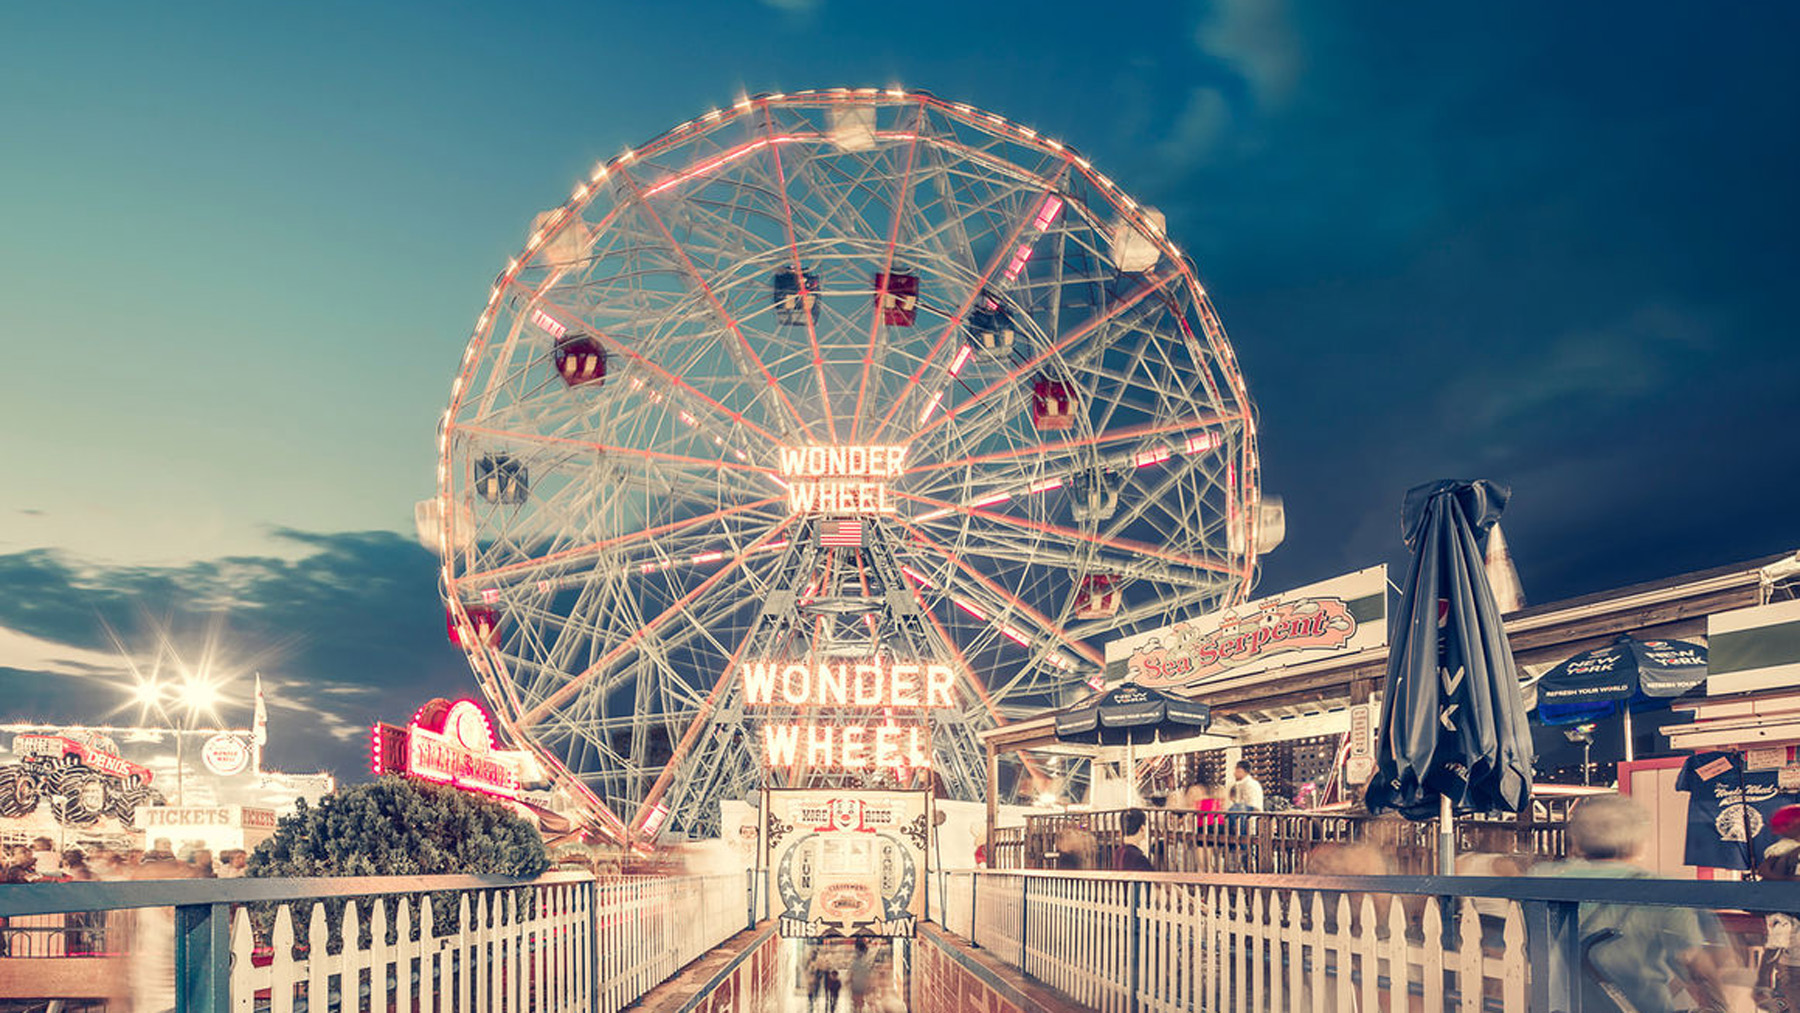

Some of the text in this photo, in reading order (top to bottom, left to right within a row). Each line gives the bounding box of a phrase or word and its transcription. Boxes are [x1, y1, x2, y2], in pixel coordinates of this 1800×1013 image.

[780, 446, 908, 477] WONDER
[788, 482, 896, 512] WHEEL
[1143, 610, 1328, 679] Sea Serpent
[1566, 663, 1615, 675] YORK
[1568, 654, 1621, 668] NEW
[743, 663, 956, 706] WONDER
[1578, 686, 1599, 694] YOUR
[1600, 684, 1629, 692] WORLD
[765, 725, 931, 767] WHEEL
[147, 808, 276, 827] TICKETS TICKETS
[802, 850, 811, 889] FUN
[781, 917, 917, 937] THIS WAY
